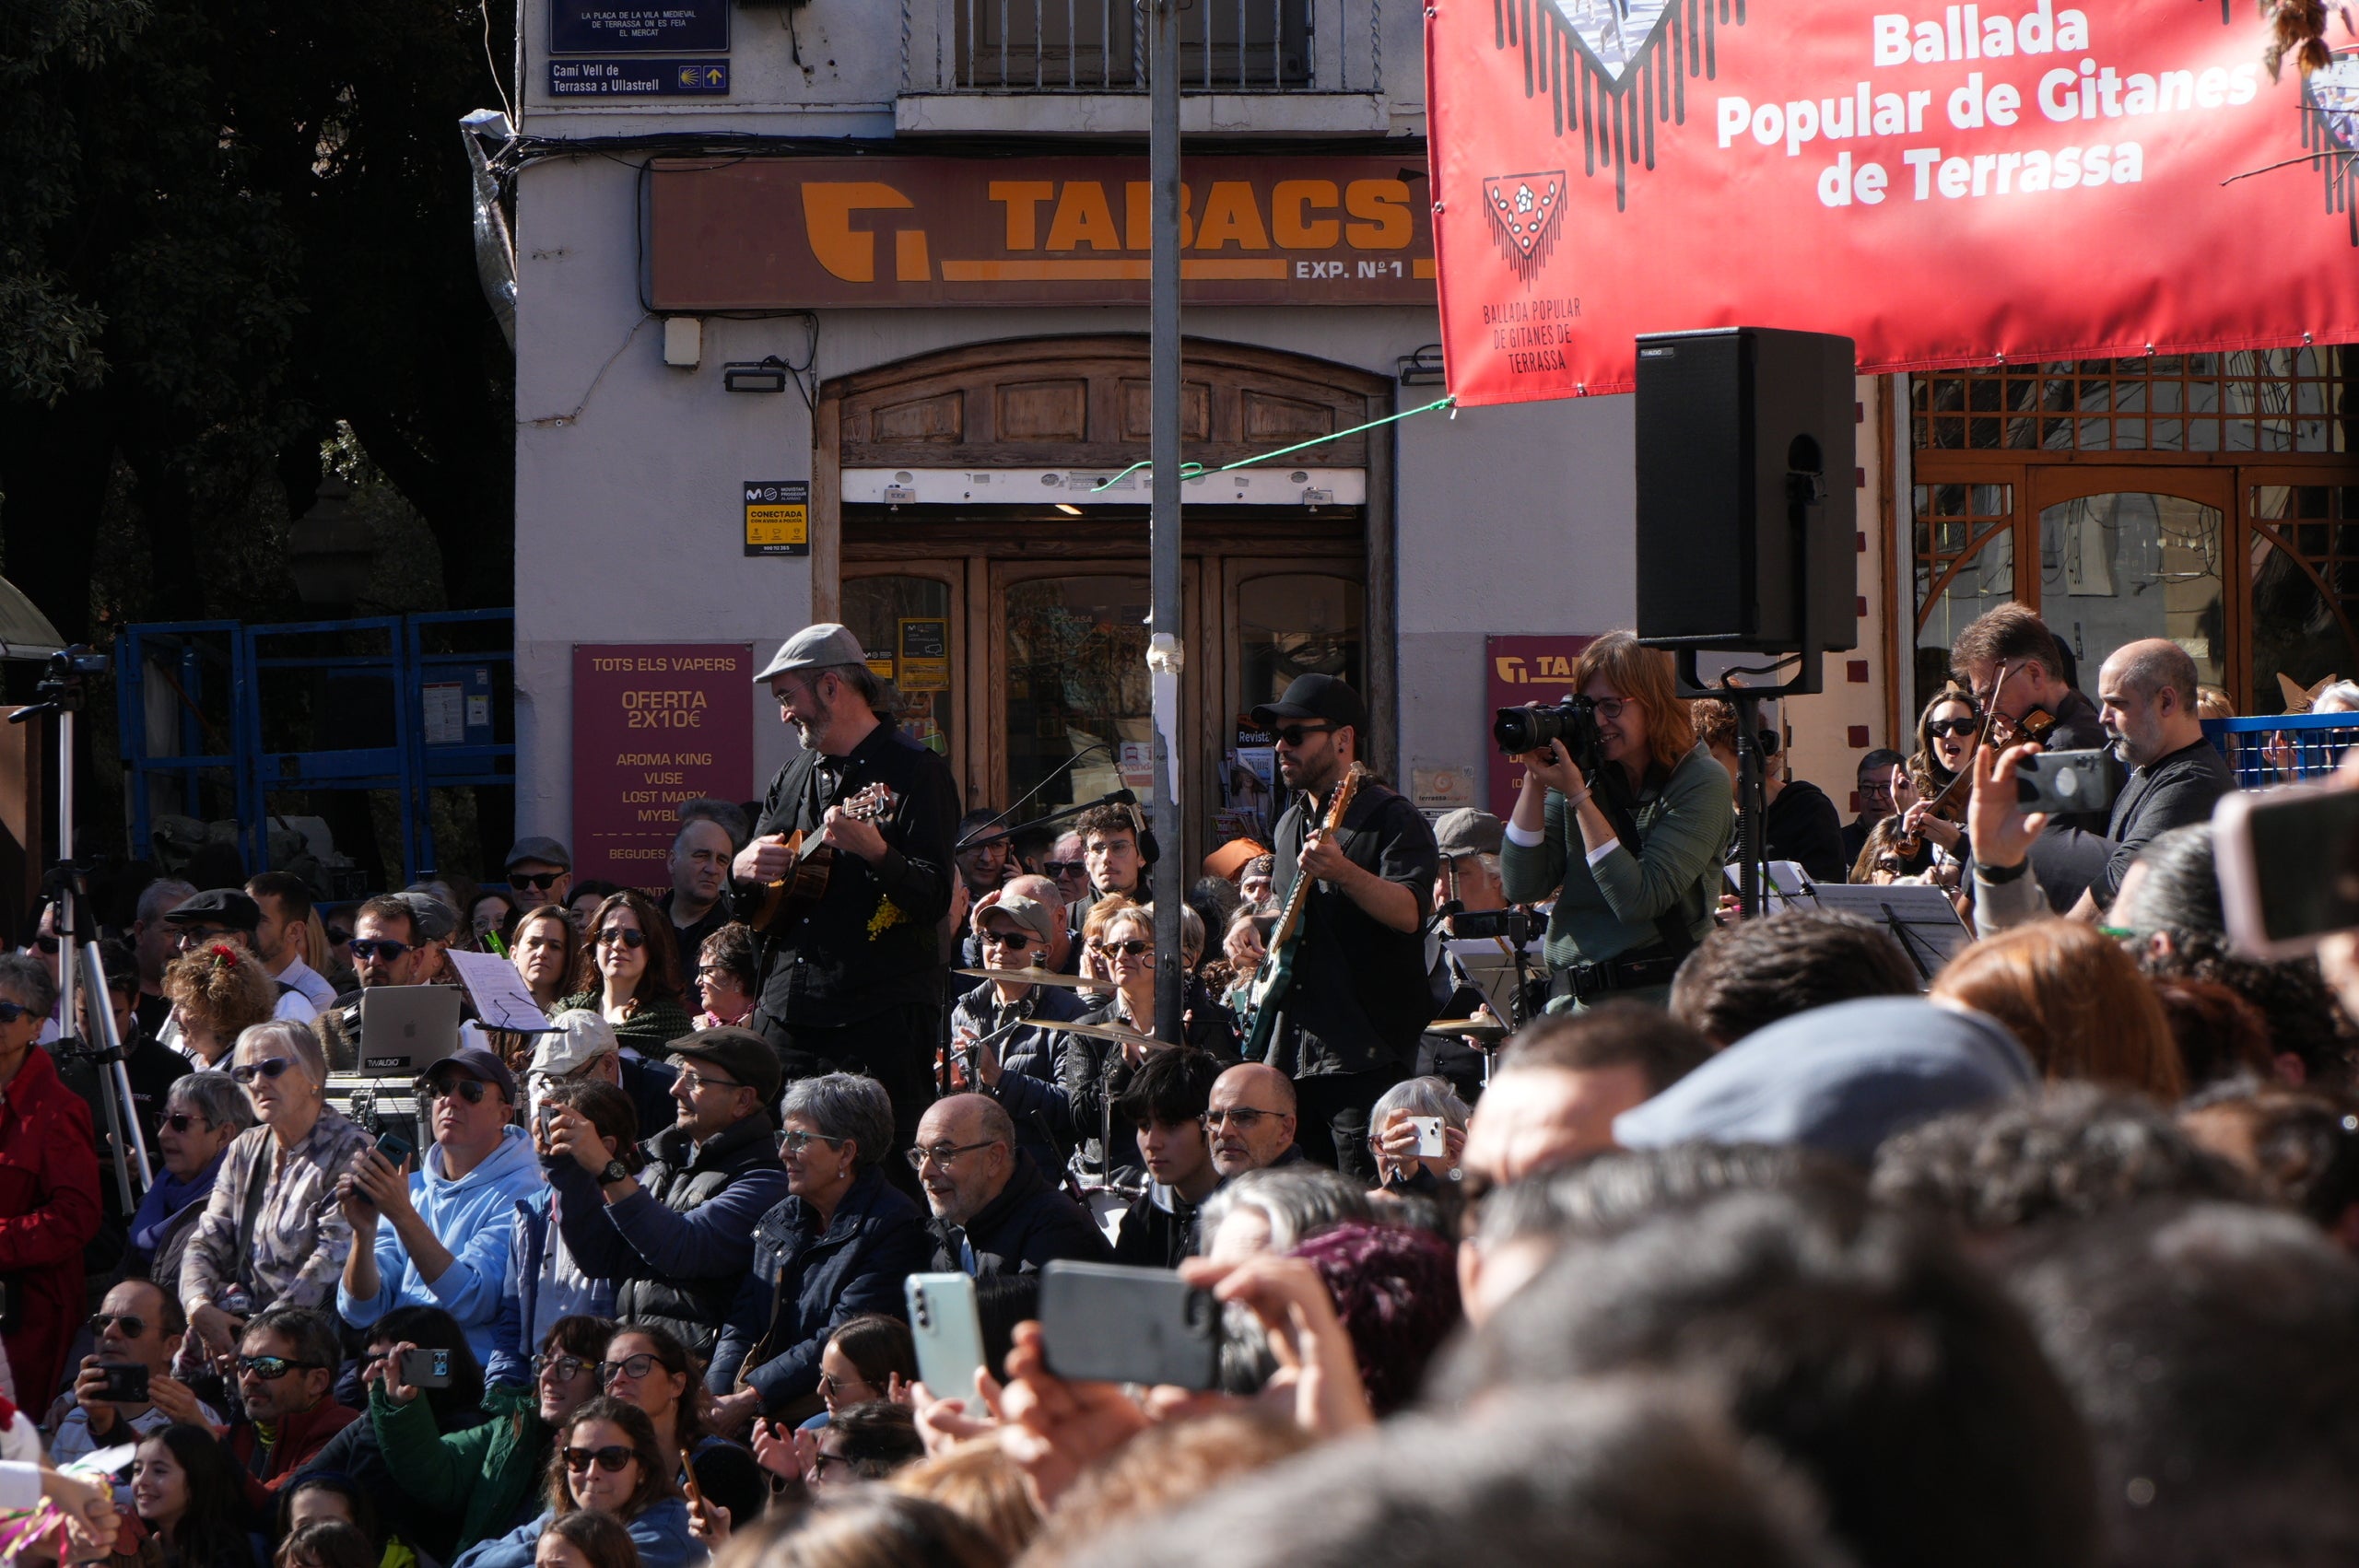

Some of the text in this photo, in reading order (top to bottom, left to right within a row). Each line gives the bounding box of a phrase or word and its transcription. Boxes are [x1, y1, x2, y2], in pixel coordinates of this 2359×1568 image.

[618, 11, 628, 19] DE
[630, 11, 640, 19] LA
[643, 11, 660, 19] VILA
[663, 10, 697, 18] MEDIEVAL
[644, 19, 654, 28] ON
[631, 29, 660, 37] MERCAT
[1873, 2, 2090, 67] Ballada
[553, 64, 619, 76] Camí Vell de
[554, 79, 660, 92] Terrassa a Ullastrell
[1717, 57, 2259, 157] Popular de Gitanes
[1817, 141, 2144, 208] de Terrassa
[1296, 261, 1350, 278] EXP.
[1483, 298, 1582, 325] BALLADA POPULAR
[1494, 323, 1572, 350] DE GITANES DE
[1508, 349, 1567, 374] TERRASSA
[593, 658, 736, 672] TOTS ELS VAPERS
[621, 691, 708, 709] OFERTA
[628, 709, 701, 728] 2X10€
[616, 753, 712, 766] AROMA KING
[644, 772, 684, 785] VUSE
[622, 790, 659, 803] LOST
[638, 810, 680, 822] MYBL
[609, 848, 666, 860] BEGUDES
